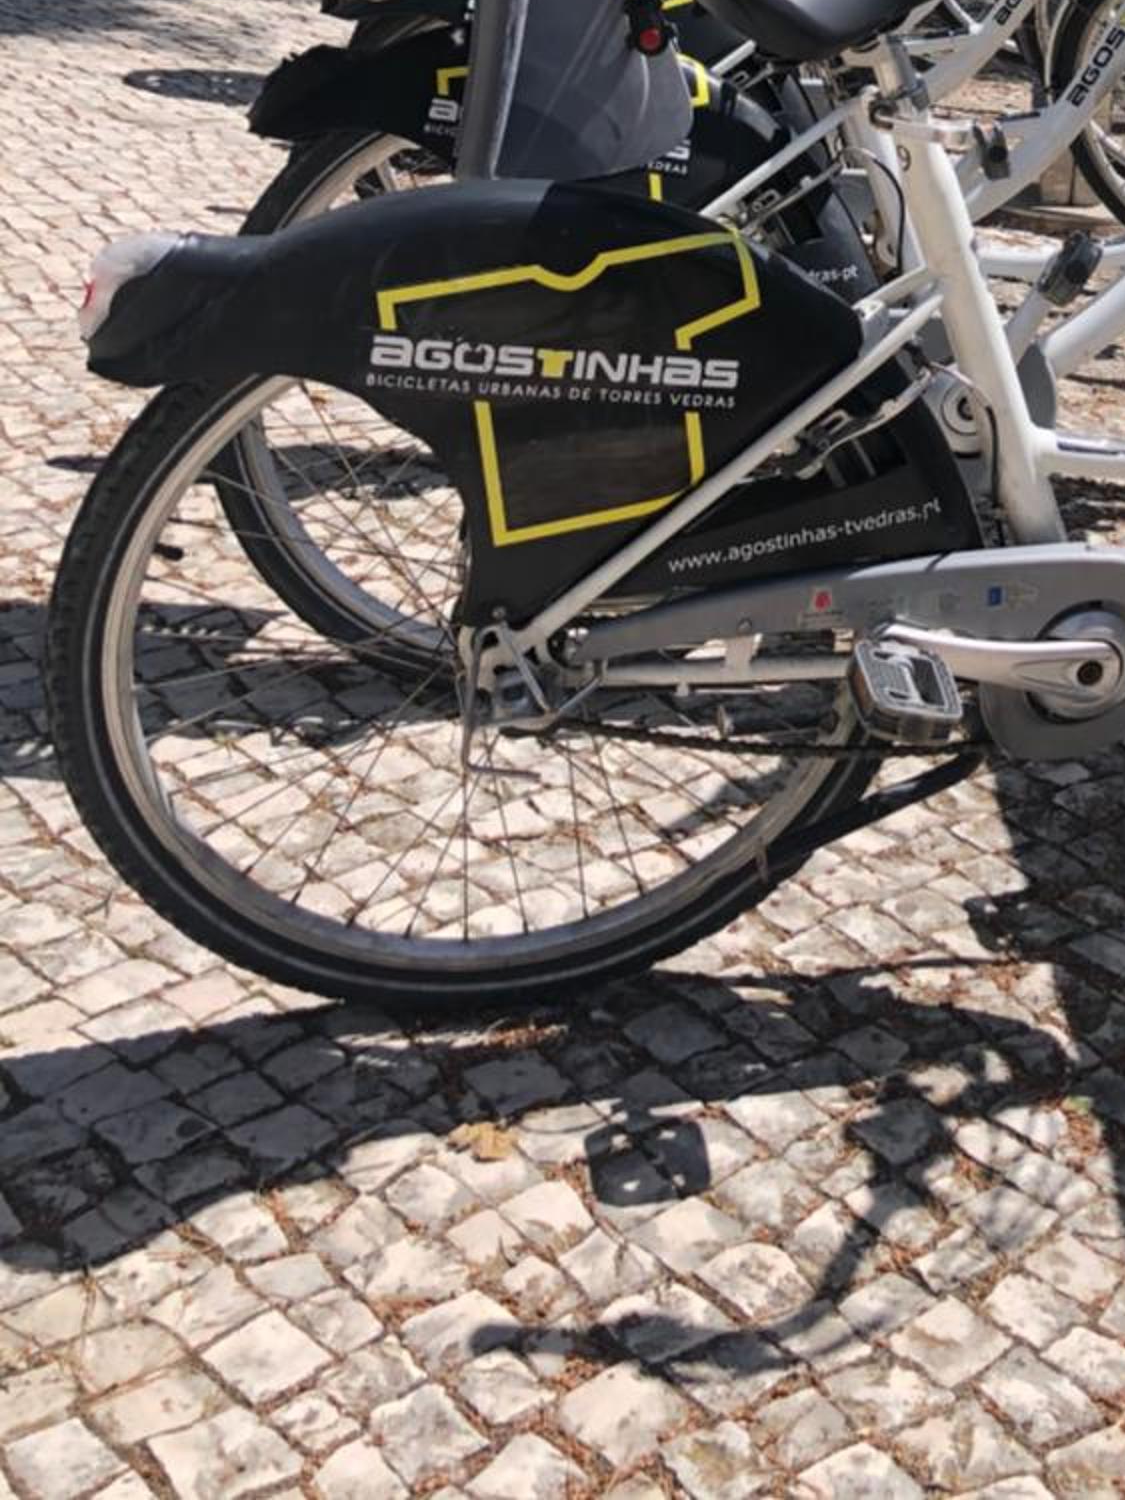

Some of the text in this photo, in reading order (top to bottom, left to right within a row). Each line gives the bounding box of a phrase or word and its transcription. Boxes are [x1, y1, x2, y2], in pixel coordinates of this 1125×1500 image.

[365, 372, 736, 409] BICICLETAS URBANAS DE TORRES VEDRAS
